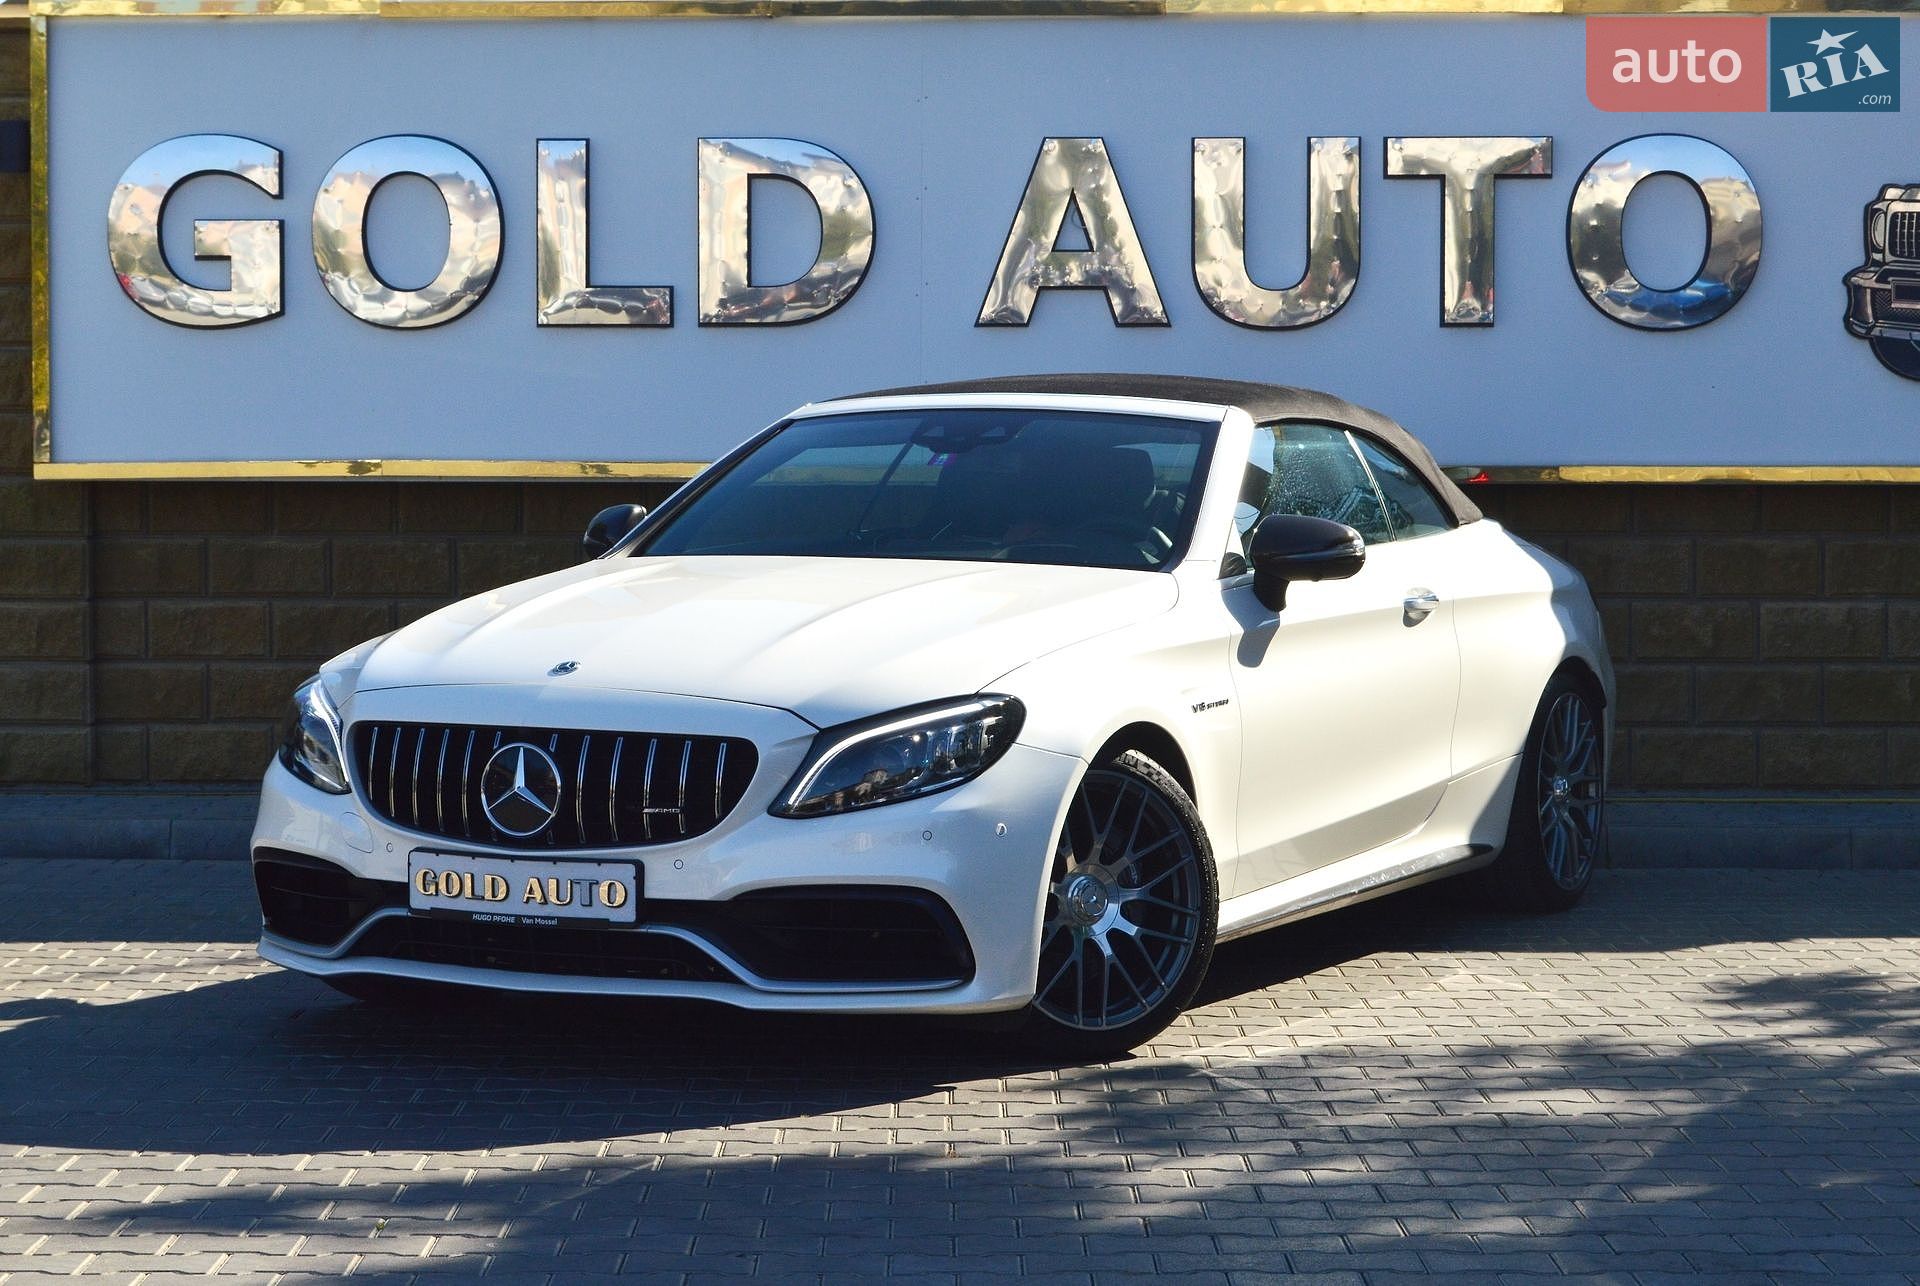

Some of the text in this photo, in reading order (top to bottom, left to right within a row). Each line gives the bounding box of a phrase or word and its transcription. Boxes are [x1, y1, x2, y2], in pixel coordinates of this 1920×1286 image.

[107, 133, 1764, 330] GOLD AUTO
[415, 868, 628, 907] GOLD AUTO
[472, 913, 492, 922] HUGO
[521, 916, 534, 925] Van
[535, 917, 558, 926] Mossel
